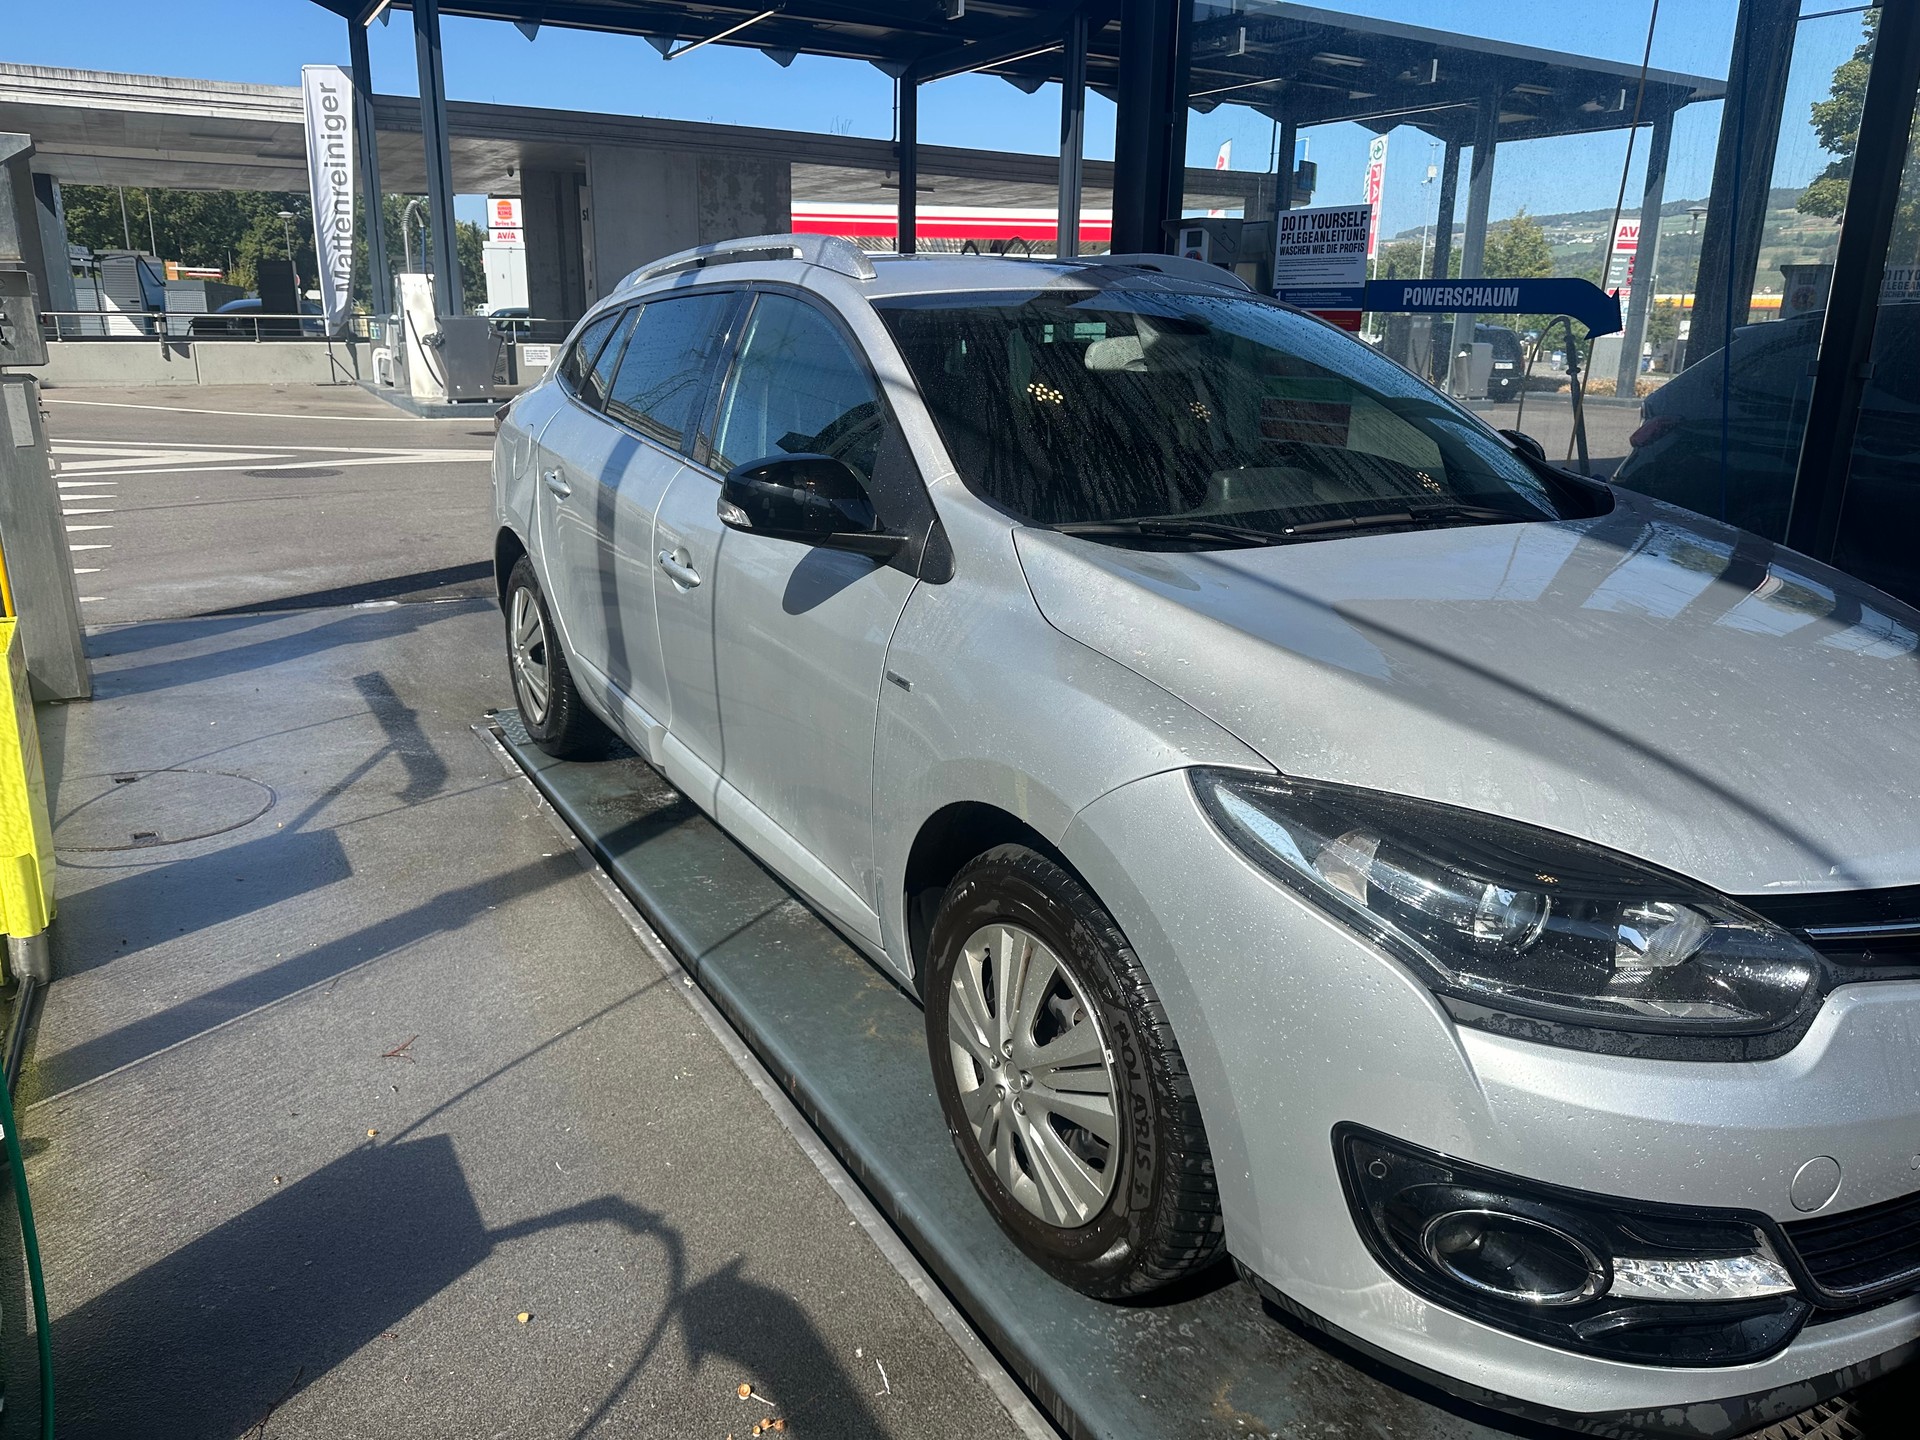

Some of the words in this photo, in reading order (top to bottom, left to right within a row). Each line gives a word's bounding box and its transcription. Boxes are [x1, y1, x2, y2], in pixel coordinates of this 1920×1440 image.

[320, 82, 352, 293] Mattenreiniger
[1281, 216, 1296, 231] DO
[1298, 214, 1309, 230] IT
[1311, 211, 1368, 230] YOURSELF
[1280, 228, 1366, 245] PFLEGEANLEITUNG
[1618, 226, 1639, 238] AV
[1279, 244, 1311, 256] WASCHEN
[1312, 244, 1325, 255] WIE
[1326, 243, 1338, 254] DIE
[1339, 242, 1365, 253] PROFIS
[1402, 286, 1519, 307] POWERSCHAUM
[1113, 1020, 1150, 1171] POLARIS
